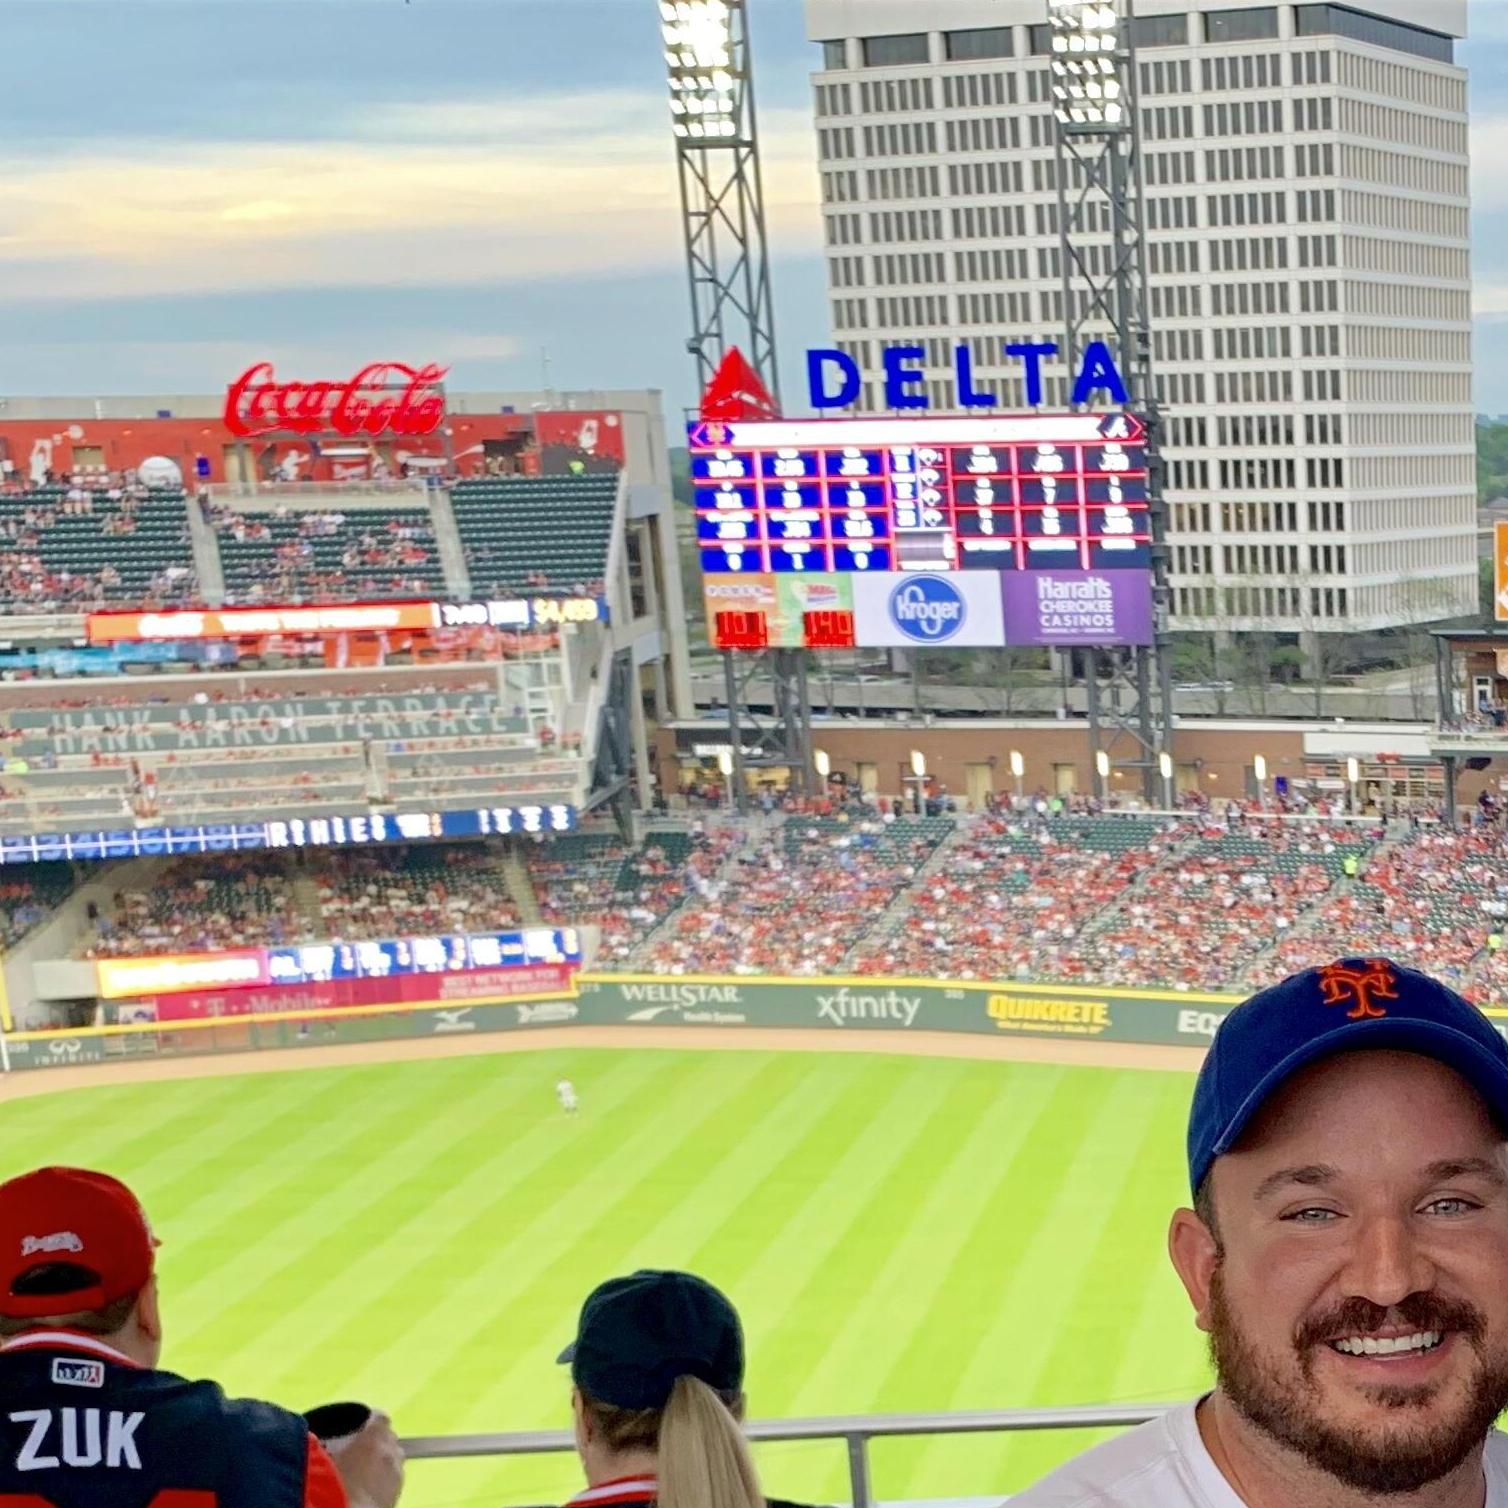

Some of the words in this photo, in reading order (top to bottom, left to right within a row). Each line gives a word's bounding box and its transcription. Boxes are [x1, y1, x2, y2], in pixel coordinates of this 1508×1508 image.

[806, 342, 1129, 409] DELTA
[897, 585, 961, 635] Kroger
[1039, 600, 1113, 613] CHEROKEE
[1040, 614, 1114, 627] CASINOS
[52, 706, 155, 755] HANK
[177, 700, 310, 748] AARON
[326, 693, 510, 739] TERRACE
[621, 984, 743, 1006] WELLSTAR
[817, 988, 921, 1026] xfinity
[987, 994, 1112, 1025] QUIKRETE
[9, 1408, 146, 1472] ZUK
